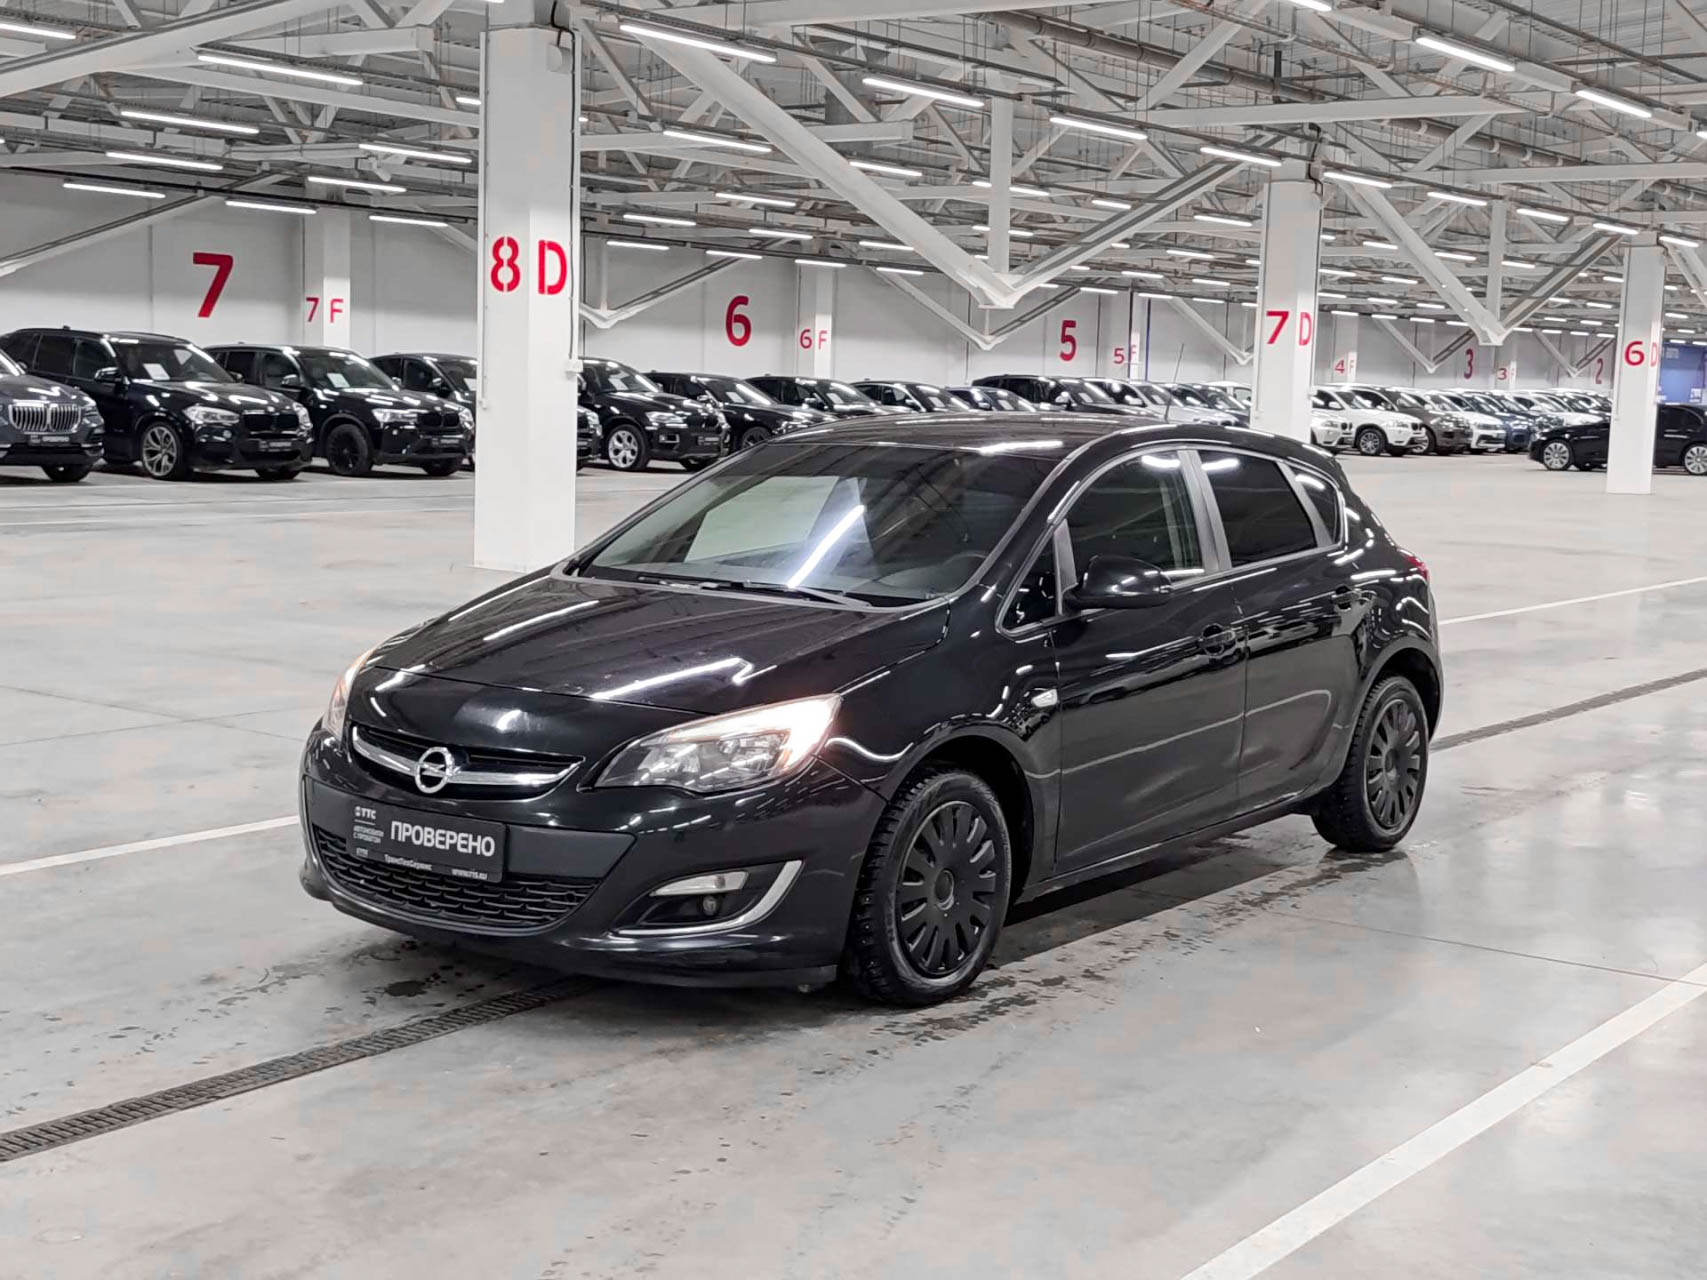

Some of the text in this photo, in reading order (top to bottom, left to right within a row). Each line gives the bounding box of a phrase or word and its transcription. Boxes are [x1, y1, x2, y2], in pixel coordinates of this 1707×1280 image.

[491, 236, 568, 295] 8 D
[193, 252, 235, 318] 7
[306, 296, 344, 323] 7 F
[725, 295, 752, 347] 6
[800, 328, 813, 350] 6
[1060, 319, 1077, 362] 5
[1265, 310, 1313, 346] 7 D
[1113, 347, 1125, 365] 5
[1464, 348, 1474, 380] 3
[1624, 340, 1645, 366] 6
[1595, 358, 1604, 384] 2
[391, 820, 496, 857] ПРОВЕРЕНО
